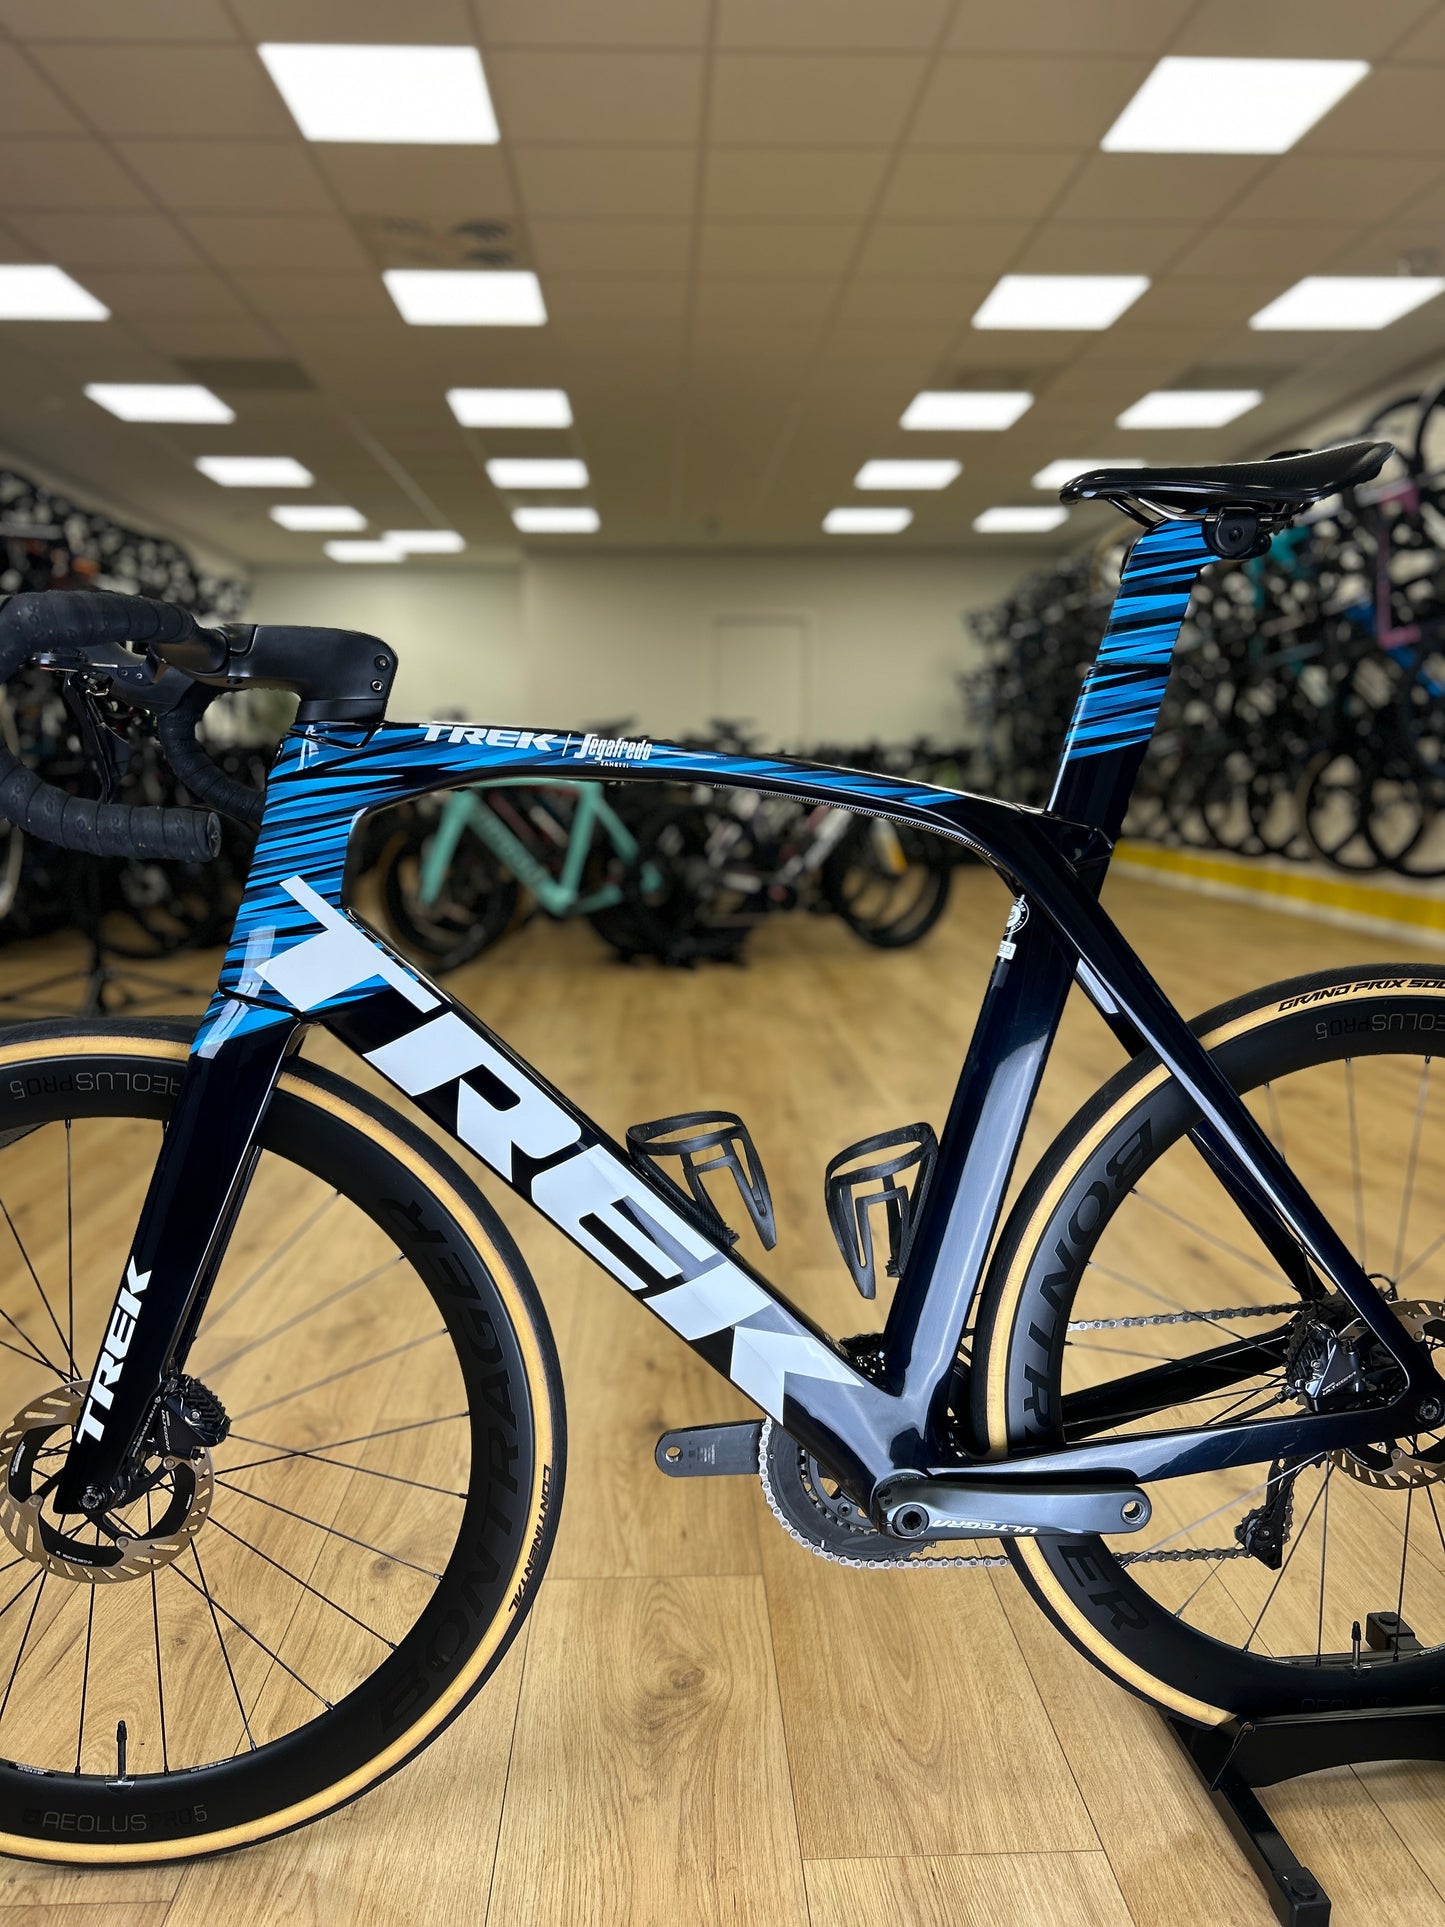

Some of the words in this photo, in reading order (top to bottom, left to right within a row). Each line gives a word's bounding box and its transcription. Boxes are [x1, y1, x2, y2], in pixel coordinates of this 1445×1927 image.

[419, 722, 558, 751] TREK
[573, 733, 653, 760] Segafredo
[600, 761, 630, 769] ZANETTI
[1278, 985, 1352, 1012] GRAND
[1351, 979, 1408, 993] PRIX
[254, 874, 864, 1426] TREK
[76, 1254, 152, 1445] TREK
[377, 1198, 519, 1735] BONTRAGER
[508, 1463, 552, 1613] CONTINENTAL
[931, 1519, 1039, 1534] ULTEGRA
